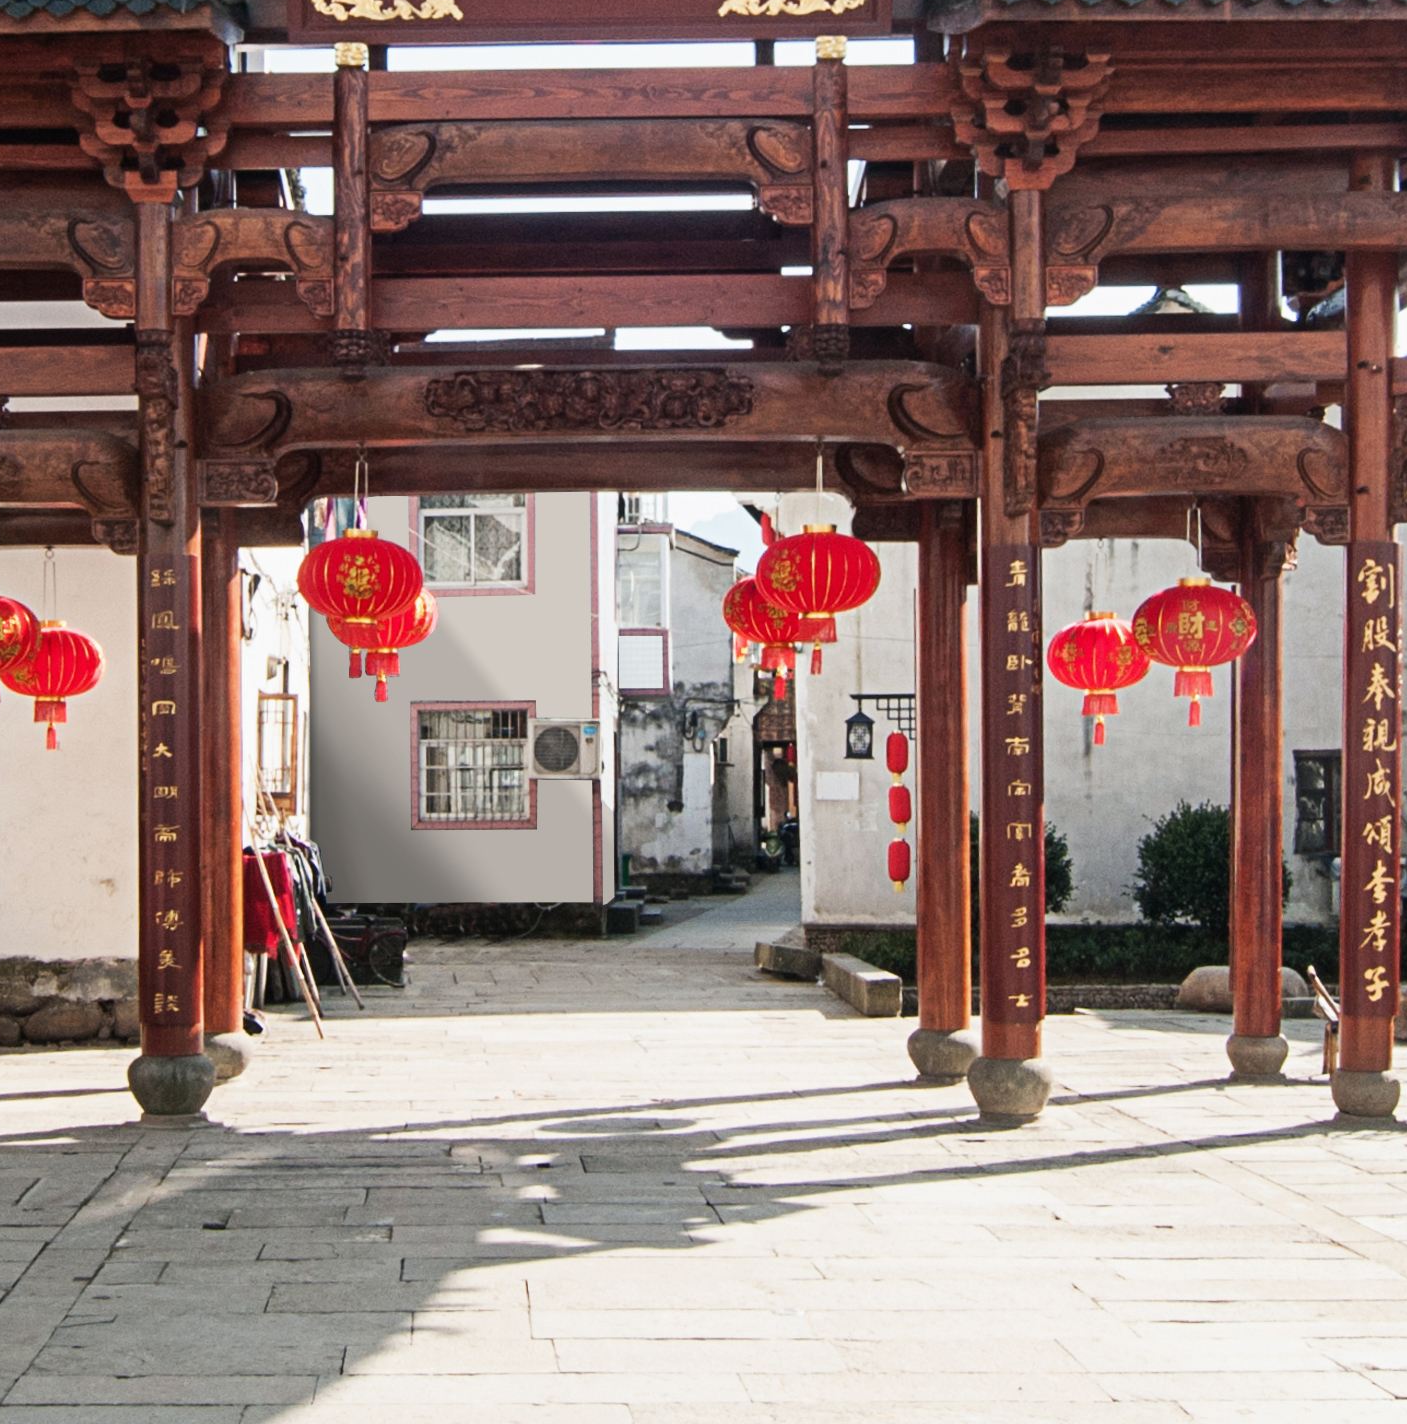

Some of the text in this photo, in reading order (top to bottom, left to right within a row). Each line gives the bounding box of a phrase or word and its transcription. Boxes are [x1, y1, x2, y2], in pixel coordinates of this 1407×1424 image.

[1357, 558, 1398, 1003] 割股奉親咸頌李孝子
